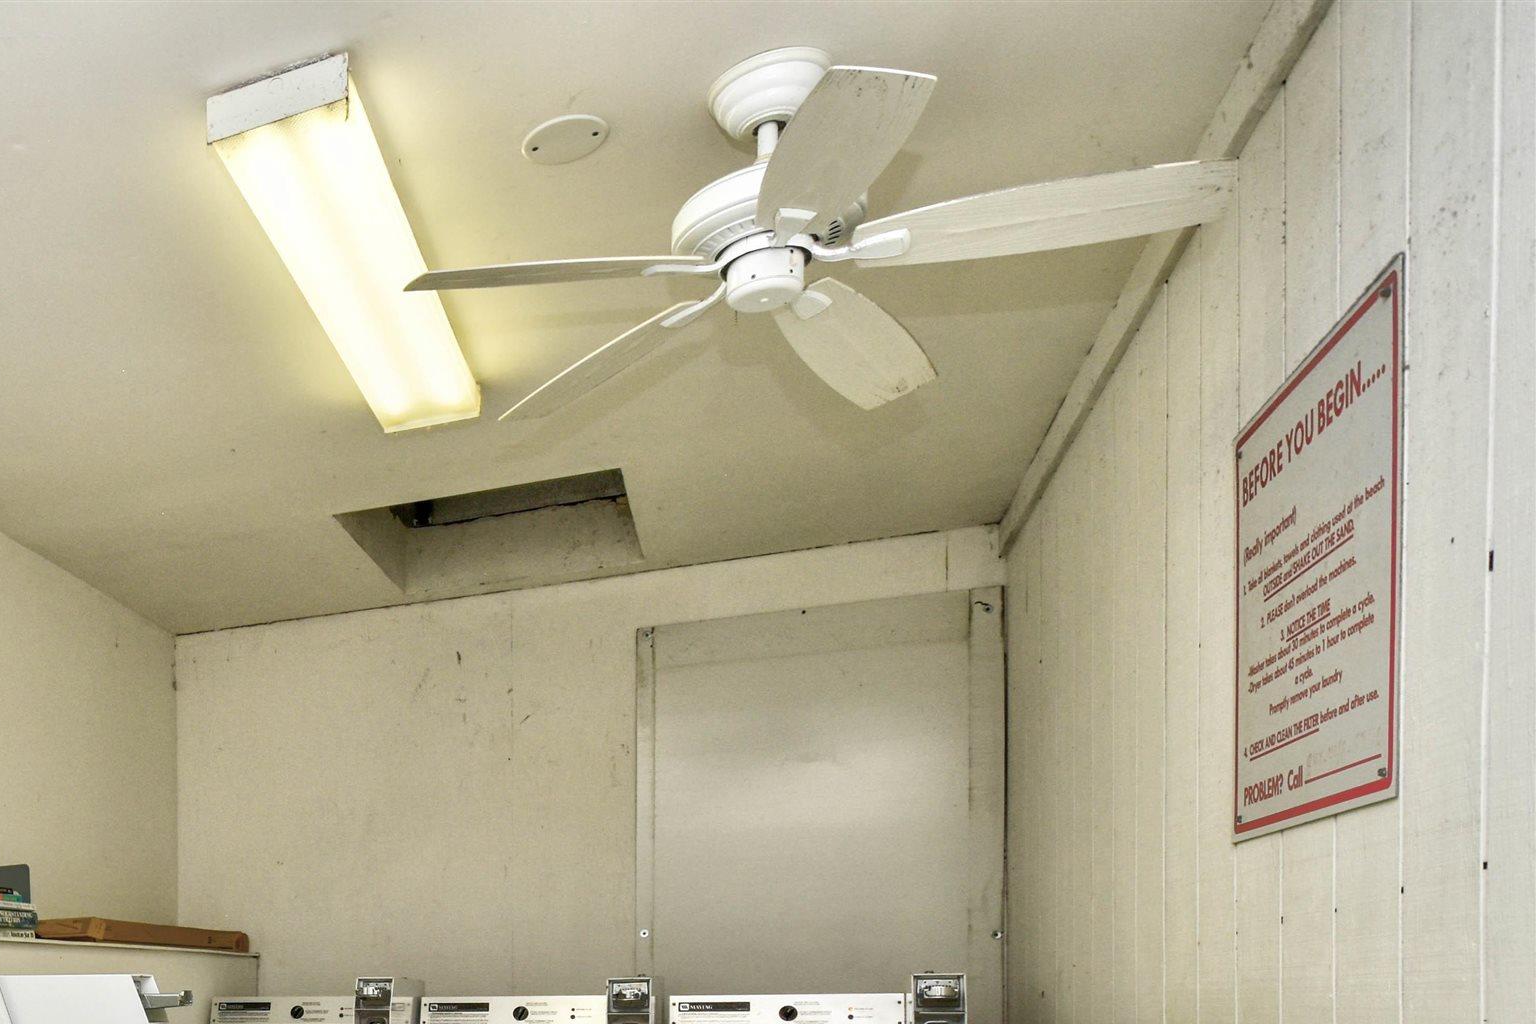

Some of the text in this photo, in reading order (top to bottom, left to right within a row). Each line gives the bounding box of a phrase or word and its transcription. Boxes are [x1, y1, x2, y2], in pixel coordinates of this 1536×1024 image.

[1243, 440, 1283, 507] BEFORE
[1286, 409, 1314, 463] YOU
[1248, 475, 1385, 591] Take towels and clothing used at the beach
[1264, 505, 1296, 546] important)
[1263, 573, 1282, 597] OUTSIDE
[1284, 569, 1292, 581] and
[1292, 551, 1311, 574] SHAKE
[1311, 540, 1324, 562] OUT
[1324, 530, 1336, 551] THE
[1266, 603, 1284, 624] PLEASE
[1284, 594, 1296, 613] don't
[1296, 579, 1318, 604] overload
[1319, 574, 1328, 588] the
[1286, 598, 1331, 637] NOTICE THE TIME
[1261, 612, 1375, 686] takes about 45 minutes hour complete
[1265, 653, 1277, 668] takes
[1277, 643, 1291, 660] about
[1291, 637, 1299, 652] 30
[1299, 629, 1319, 647] minutes
[1326, 606, 1352, 630] complete
[1269, 668, 1343, 716] Promptly remove your laundry
[1249, 739, 1265, 756] CHECK
[1265, 733, 1276, 748] AND
[1276, 725, 1293, 743] CLEAN
[1293, 719, 1303, 734] THE
[1303, 713, 1320, 731] FILTER
[1320, 707, 1338, 724] before
[1338, 698, 1350, 715] and
[1350, 693, 1365, 709] after
[1243, 765, 1304, 807] PROBLEM? Call
